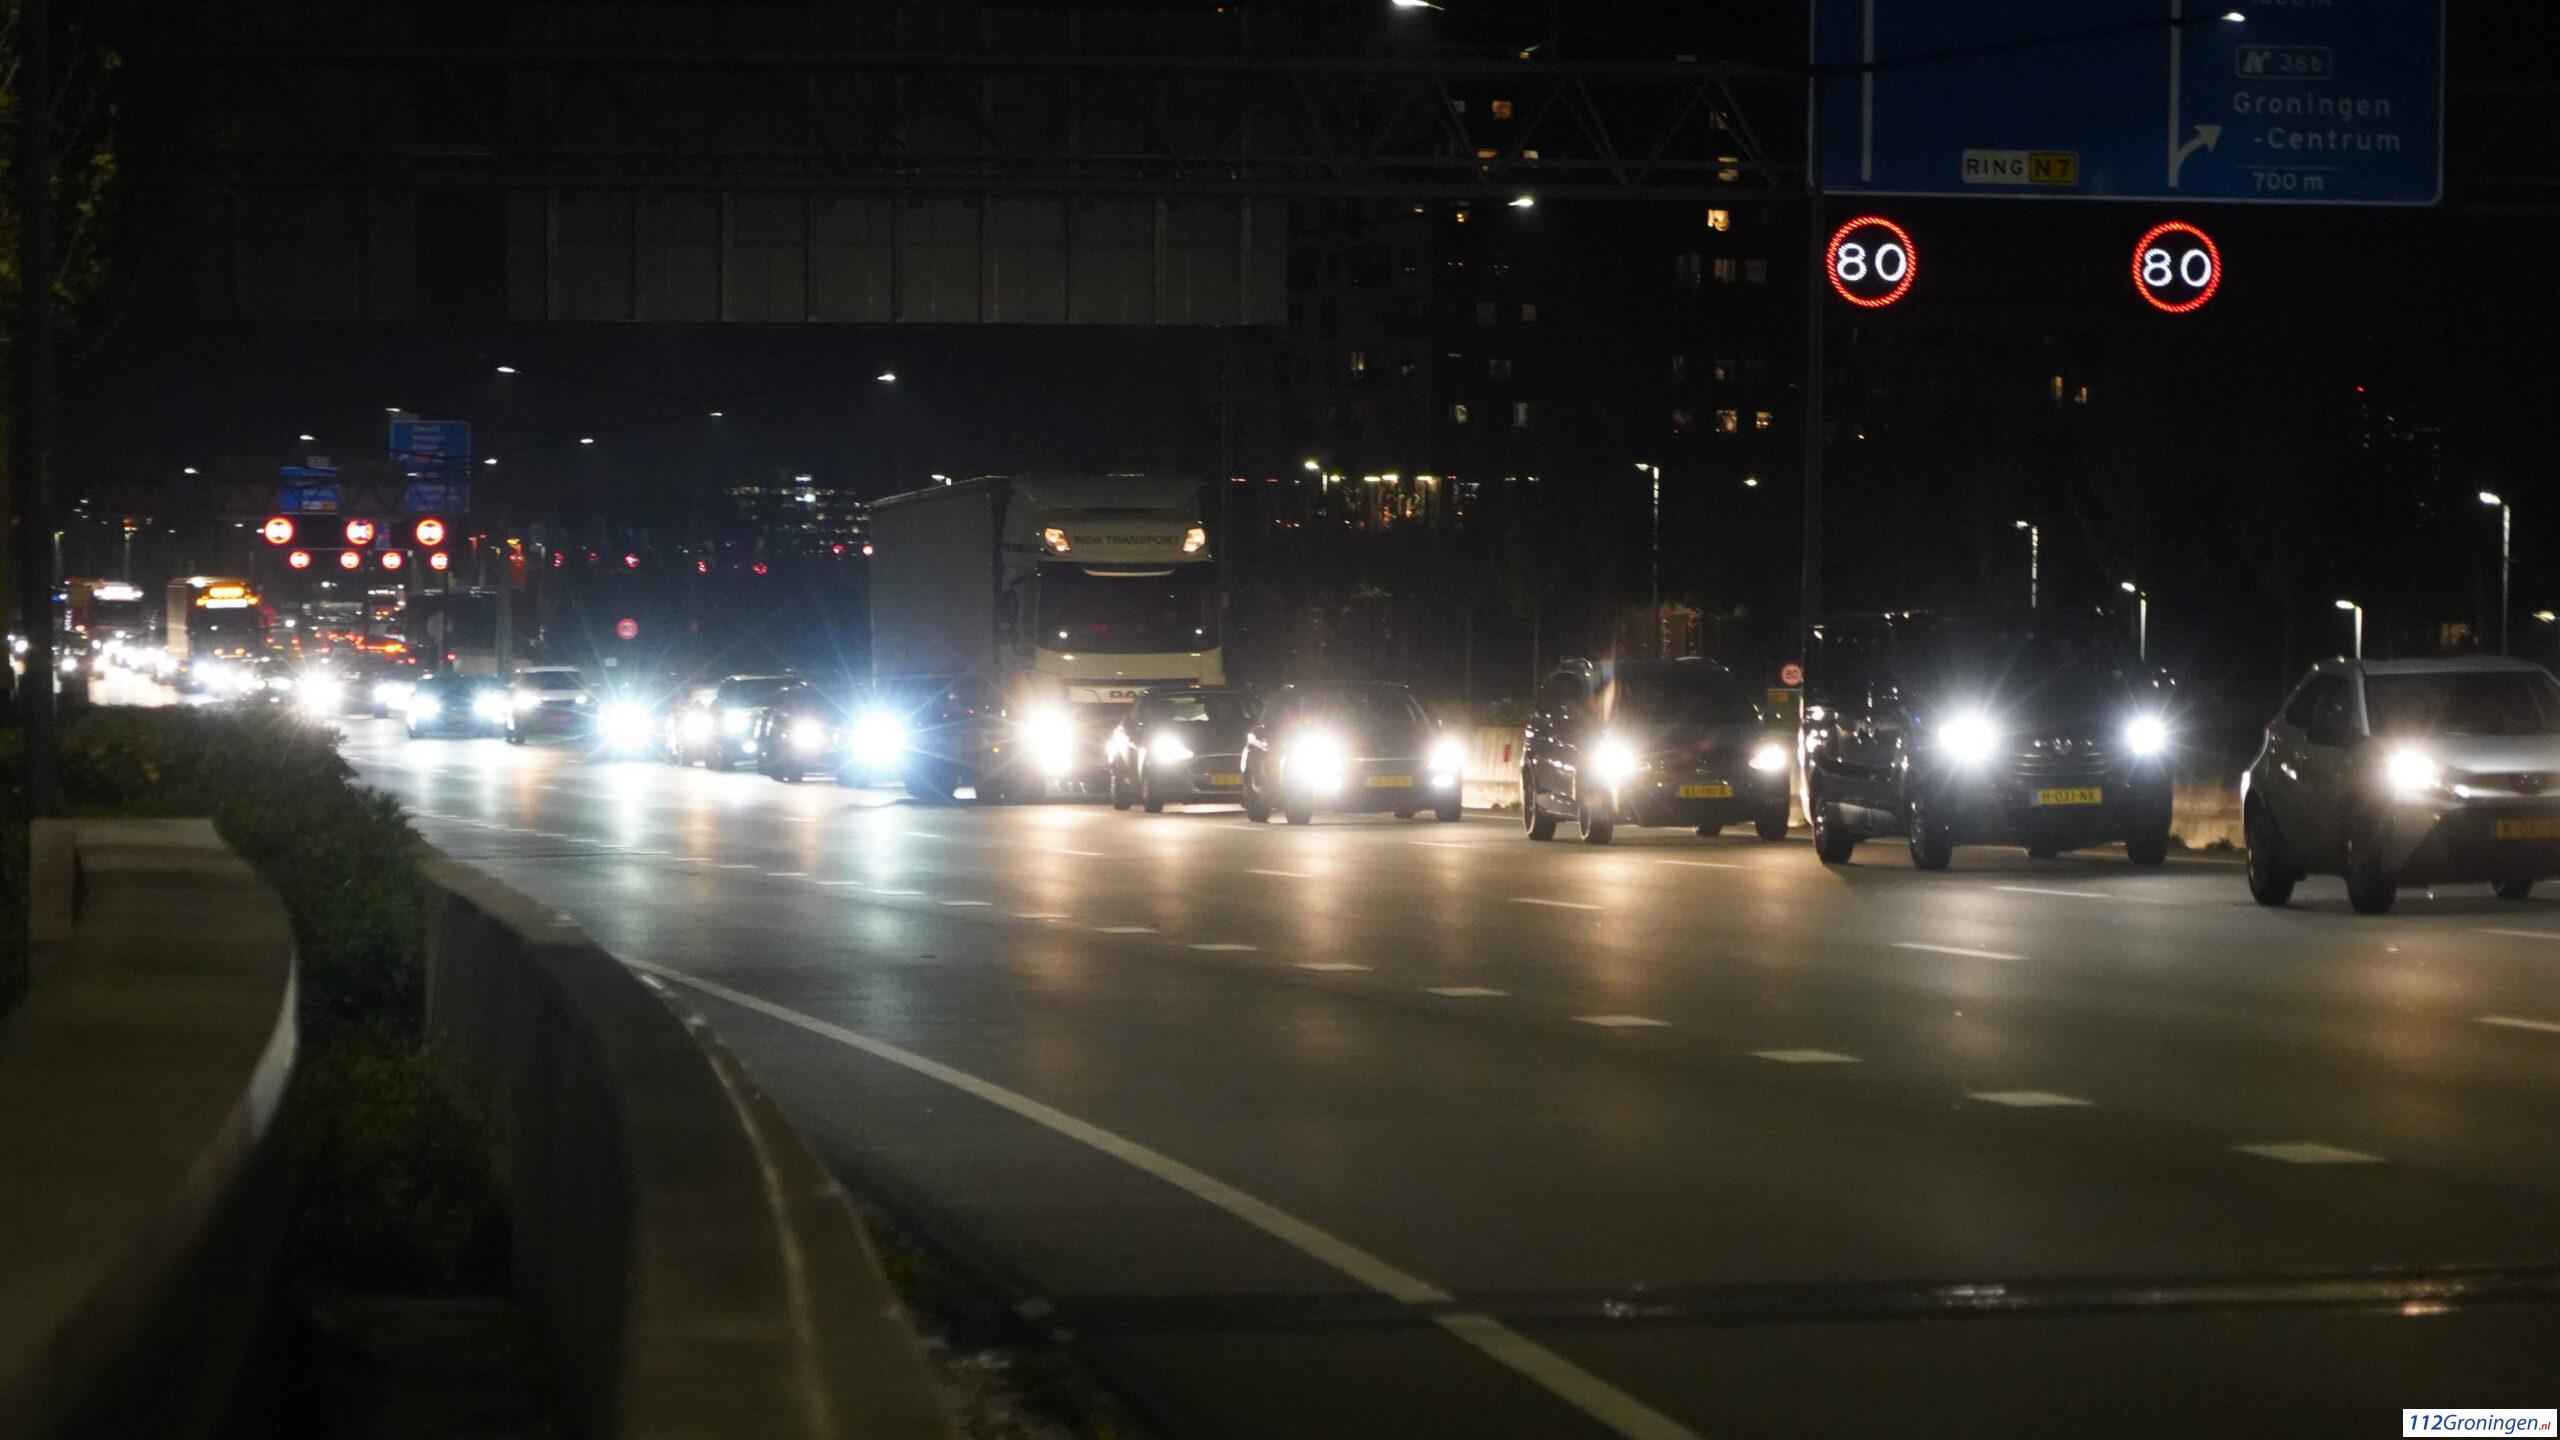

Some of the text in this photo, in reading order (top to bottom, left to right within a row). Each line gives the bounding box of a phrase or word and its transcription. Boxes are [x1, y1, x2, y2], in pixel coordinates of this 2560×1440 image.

[2233, 91, 2391, 123] Groningen
[1966, 159, 2025, 176] RING
[2252, 172, 2324, 191] 700 m
[1837, 242, 1908, 281] 80
[2142, 248, 2212, 287] 80
[1103, 535, 1181, 545] TRANSPORT
[1110, 690, 1142, 699] DA
